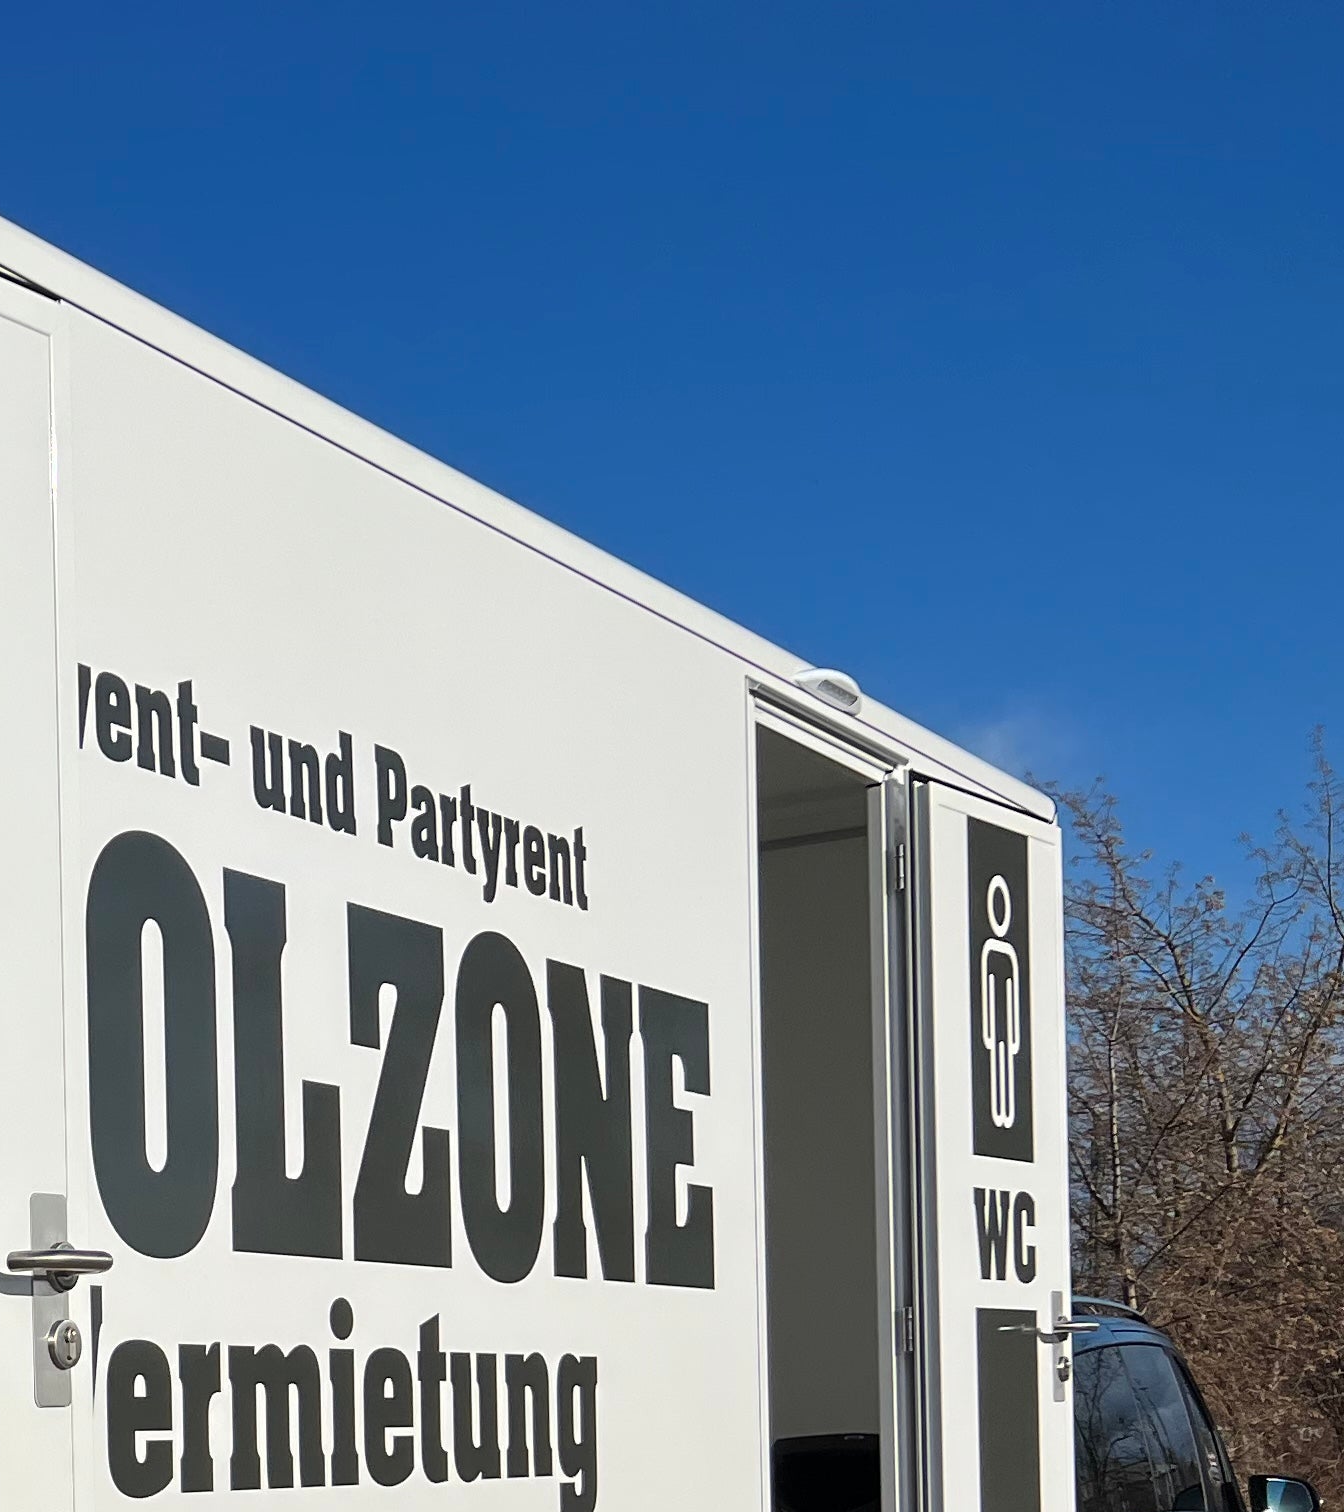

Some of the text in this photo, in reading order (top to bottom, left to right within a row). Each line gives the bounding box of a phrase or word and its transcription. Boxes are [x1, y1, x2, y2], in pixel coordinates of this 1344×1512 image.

[249, 724, 357, 835] und
[375, 743, 588, 911] Partyrent
[86, 830, 715, 1290] OLZONE
[973, 1187, 1036, 1284] WC
